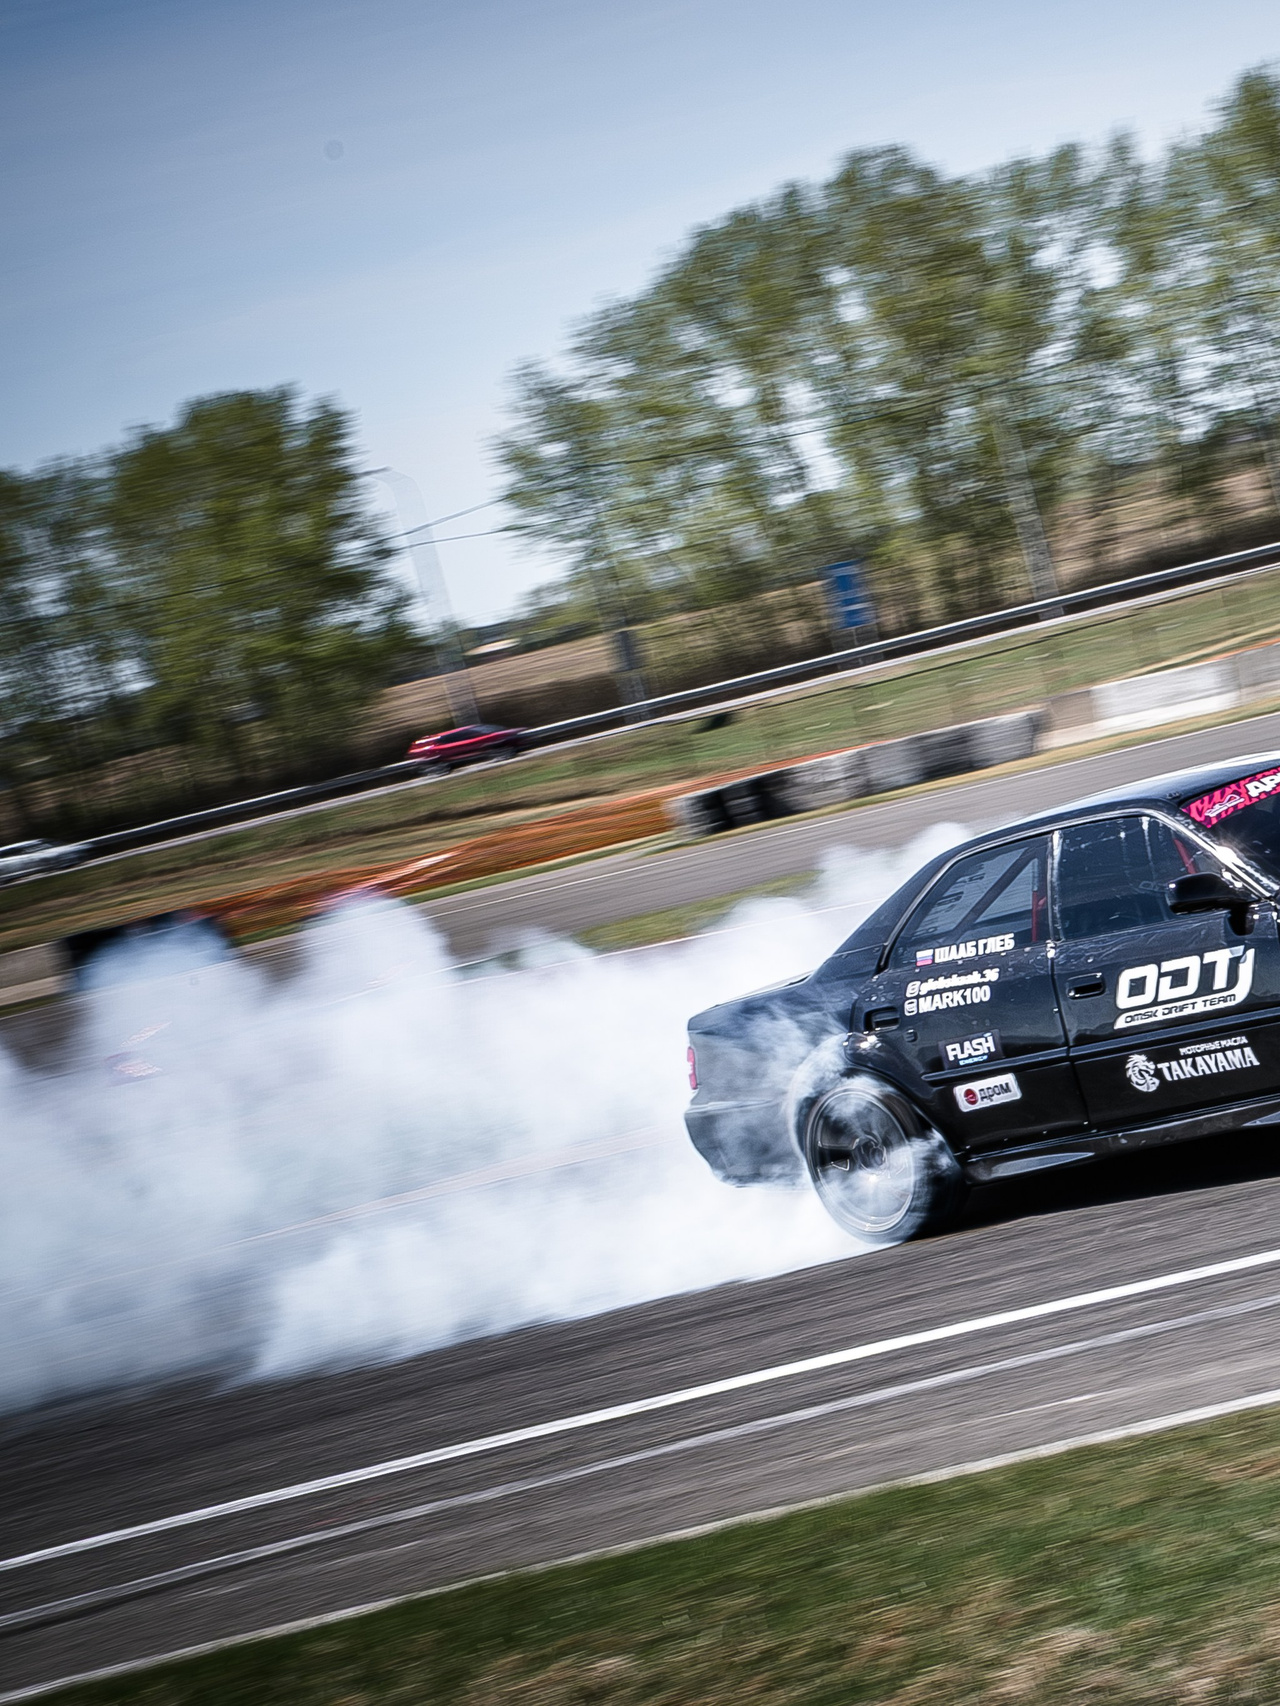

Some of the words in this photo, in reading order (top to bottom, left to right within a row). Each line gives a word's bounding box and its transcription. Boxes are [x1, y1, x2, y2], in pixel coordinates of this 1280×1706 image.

[977, 933, 1015, 955] ГЛЕБ
[1124, 1009, 1159, 1024] OMSK
[1161, 1001, 1198, 1016] DRIFT
[1201, 993, 1236, 1008] TEAM
[945, 1032, 996, 1061] FLASH
[1156, 1047, 1260, 1081] TAKAYAMA
